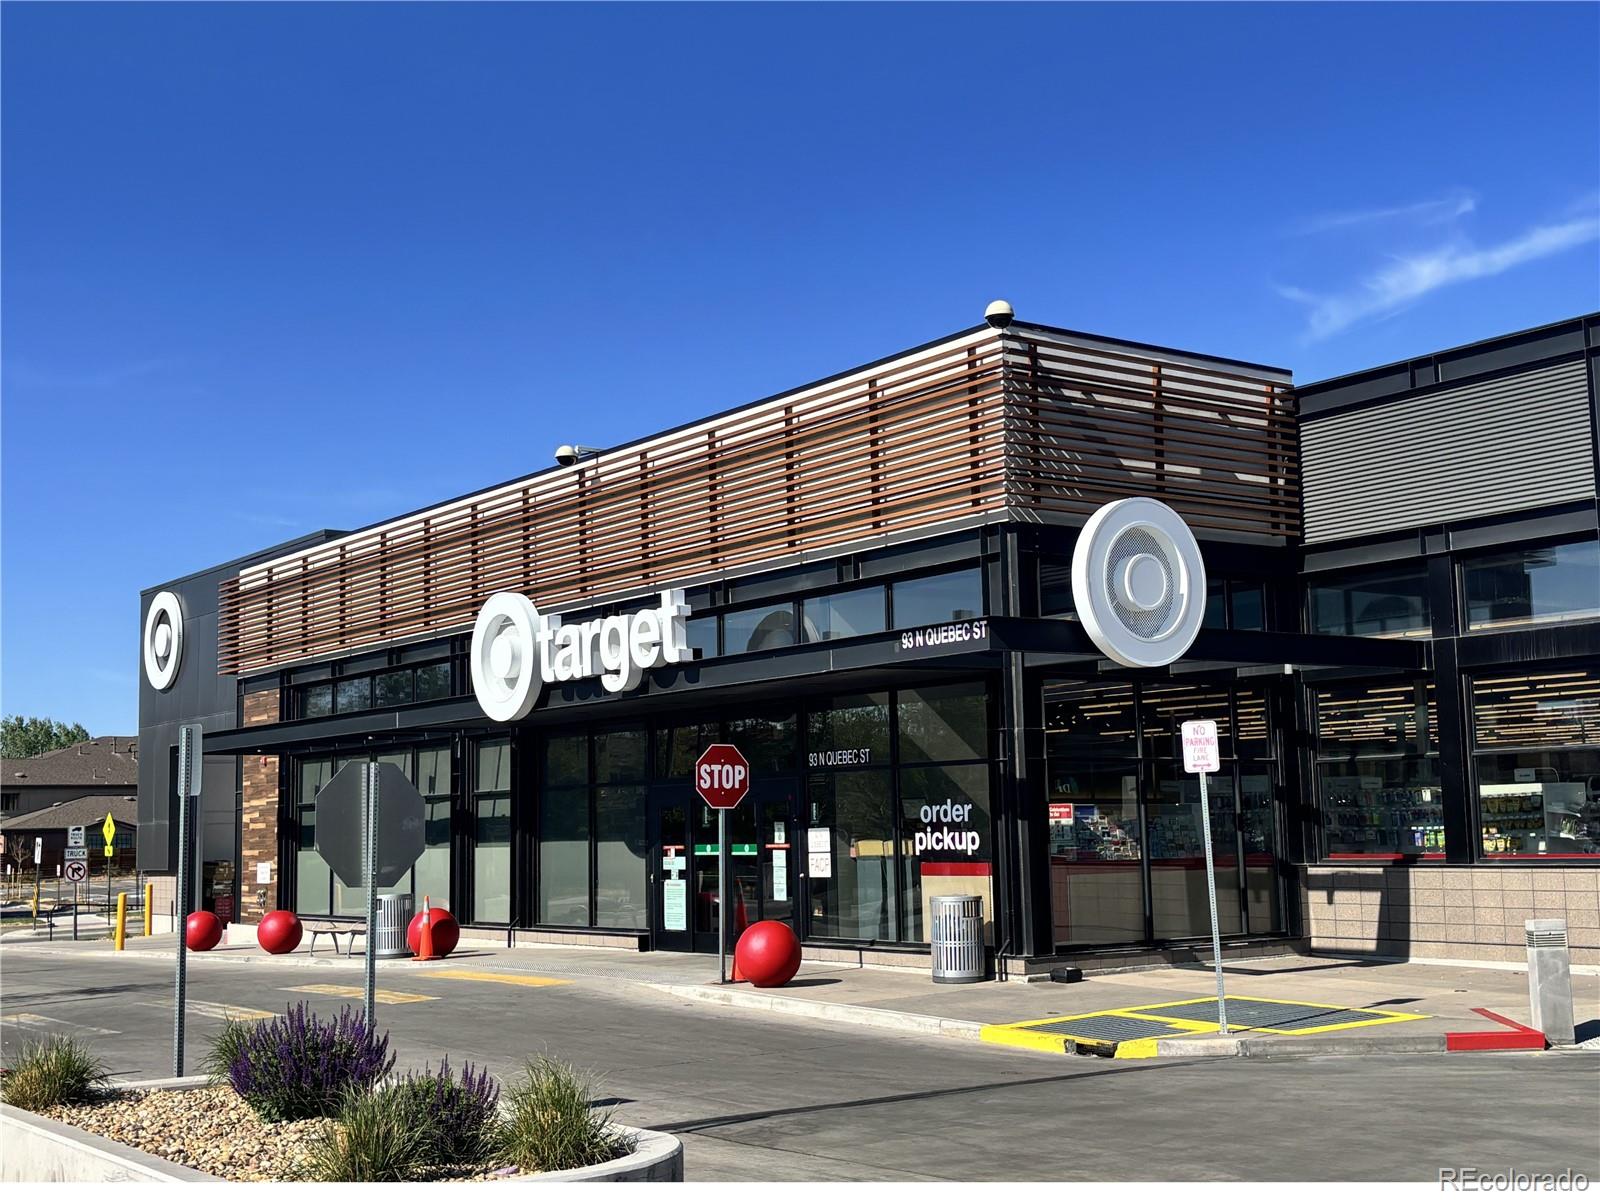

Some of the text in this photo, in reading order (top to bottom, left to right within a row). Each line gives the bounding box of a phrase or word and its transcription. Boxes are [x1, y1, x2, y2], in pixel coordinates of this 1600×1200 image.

[537, 588, 692, 693] target
[901, 621, 987, 650] 93 N QUEBEC ST
[1185, 737, 1214, 746] PARKING
[1193, 726, 1206, 736] NO
[808, 748, 870, 767] 93 N QUEBEC ST
[699, 763, 746, 789] STOP
[920, 799, 972, 825] order
[915, 827, 980, 856] pickup
